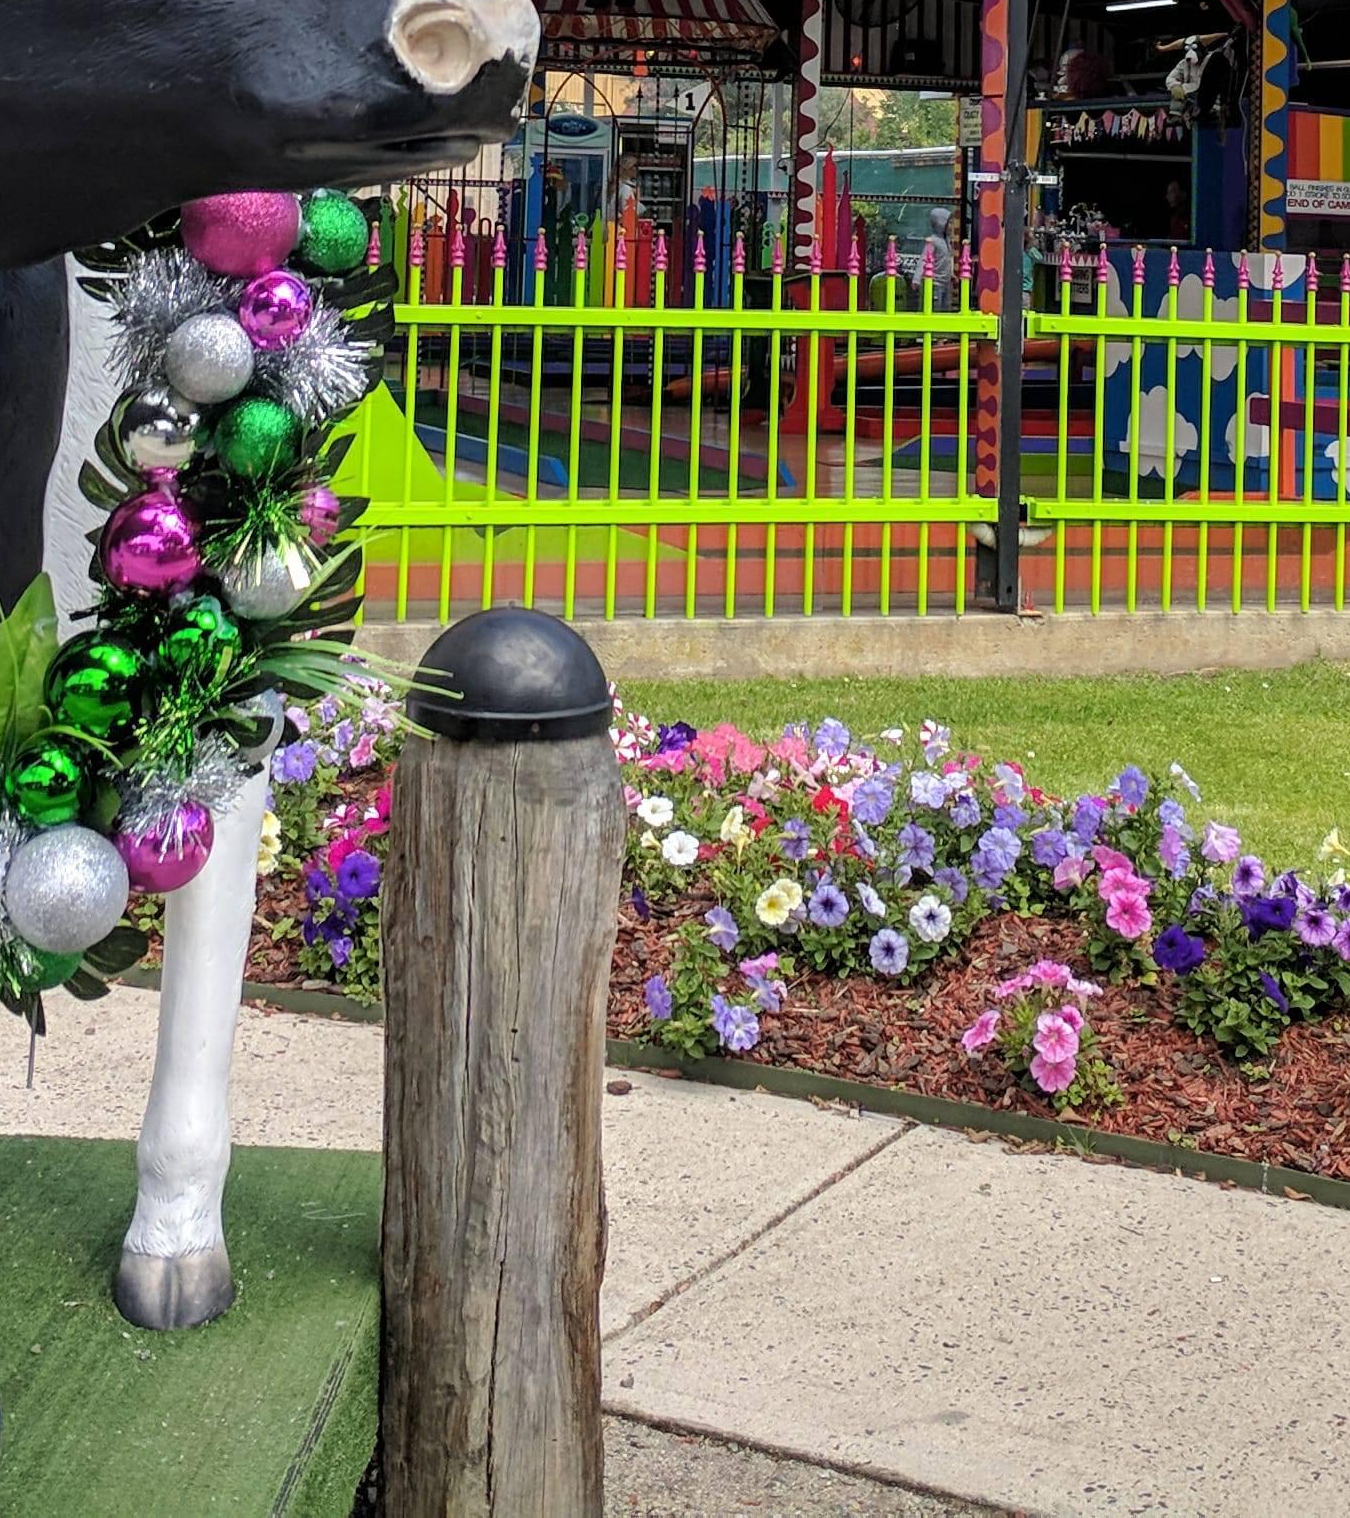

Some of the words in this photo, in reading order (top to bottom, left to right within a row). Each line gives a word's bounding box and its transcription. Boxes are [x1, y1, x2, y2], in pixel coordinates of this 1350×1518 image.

[685, 92, 696, 111] 1
[1287, 198, 1310, 208] END
[1312, 199, 1326, 209] OF
